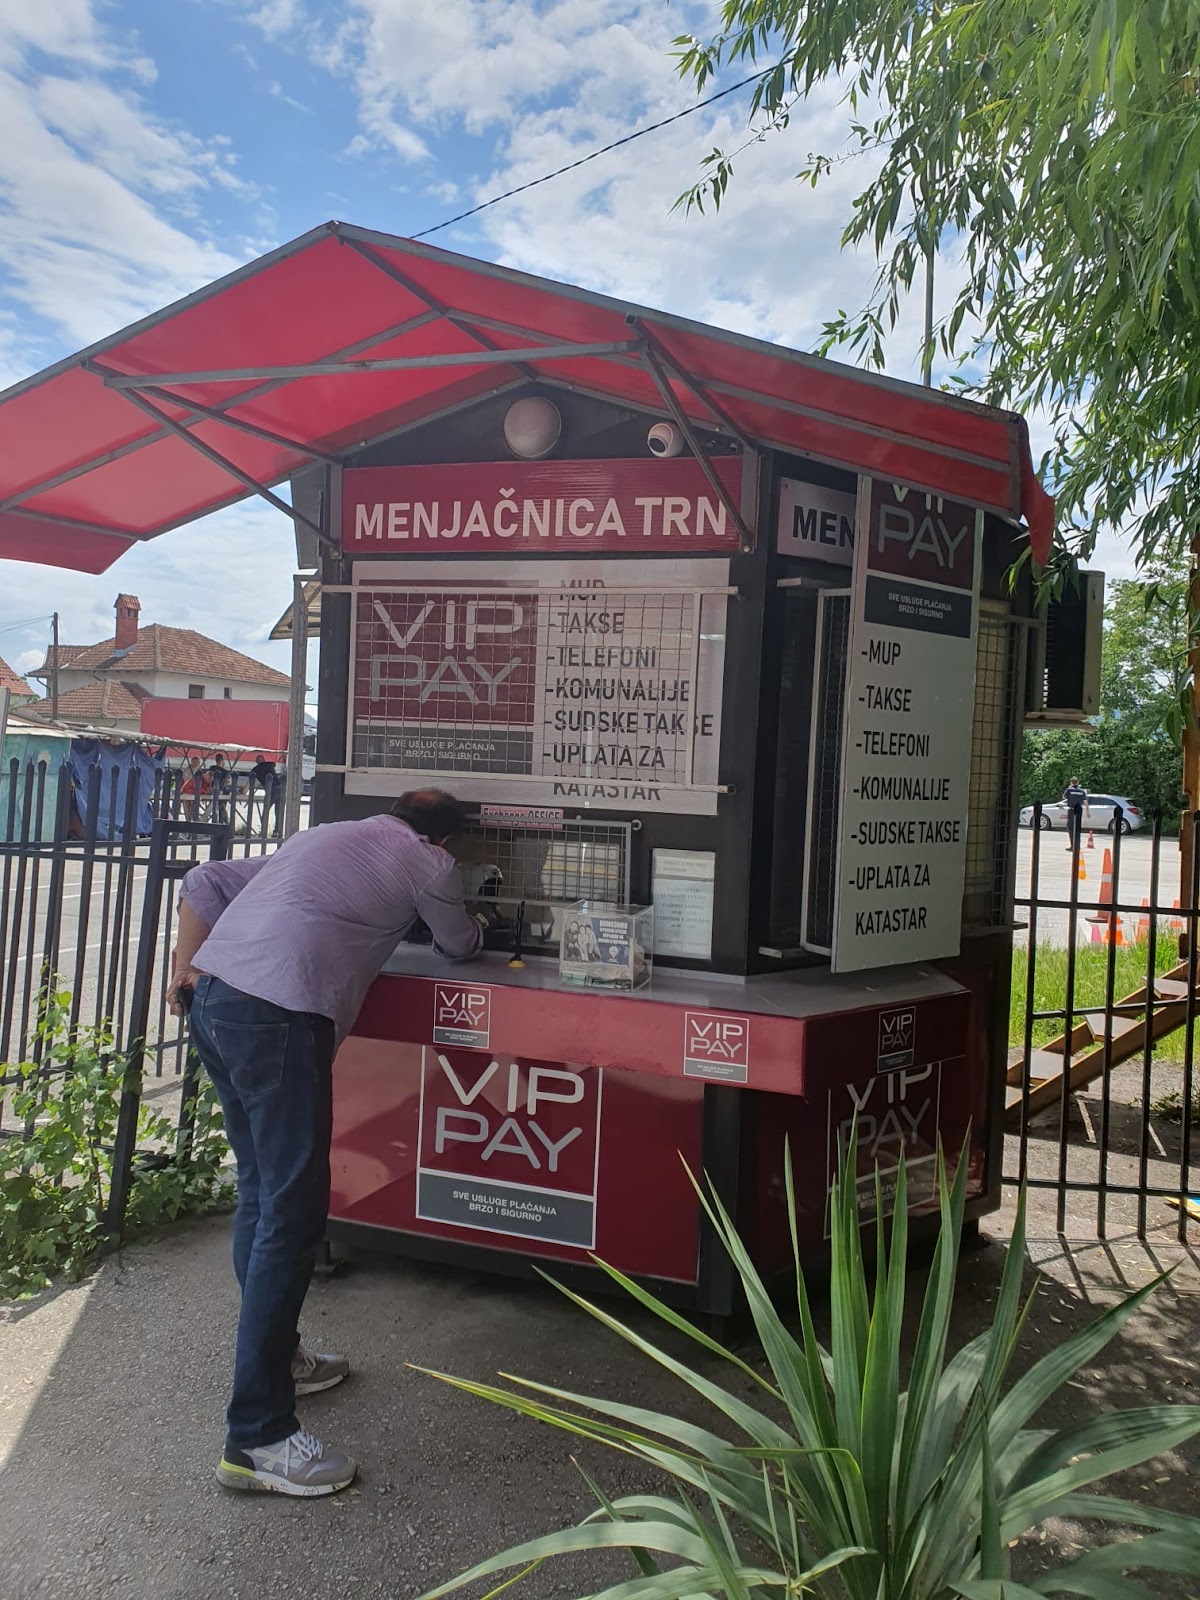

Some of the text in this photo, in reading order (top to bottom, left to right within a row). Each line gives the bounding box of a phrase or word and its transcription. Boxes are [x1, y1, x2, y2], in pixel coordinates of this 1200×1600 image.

[355, 487, 727, 539] MENJAČNICA TRN
[793, 505, 855, 549] MEN
[878, 503, 968, 569] PAY
[888, 592, 900, 601] SVE
[901, 595, 924, 606] USLUGE
[898, 604, 914, 614] BRZO
[918, 608, 944, 619] SIGURNO
[373, 600, 524, 650] VIP
[548, 612, 625, 634] -TAKSE
[547, 645, 657, 668] -TELEFONI
[861, 639, 901, 666] -MUP
[370, 654, 522, 705] PAY
[545, 677, 690, 702] -KOMUNALIJE
[858, 685, 912, 712] -TAKSE
[544, 709, 638, 734] -SUDSKE
[543, 742, 666, 768] -UPLATA ZA
[856, 730, 930, 757] -TELEFONI
[853, 776, 950, 801] -KOMUNALIJE
[851, 820, 960, 845] -SUDSKE TAKSE
[848, 864, 931, 891] -UPLATA ZA
[855, 906, 927, 936] KATASTAR
[440, 990, 486, 1009] VIP
[439, 1007, 485, 1026] PAY
[691, 1019, 743, 1040] VIP
[883, 1013, 913, 1033] VIP
[690, 1036, 743, 1058] PAY
[881, 1030, 912, 1050] PAY
[438, 1055, 584, 1115] VIP
[846, 1063, 933, 1111] VIP
[435, 1107, 582, 1172] PAY
[840, 1098, 931, 1158] PAY
[453, 1190, 557, 1216] SVE USLUGE PLAĆANJA
[469, 1202, 494, 1214] BRZO
[500, 1208, 542, 1223] SIGURNO
